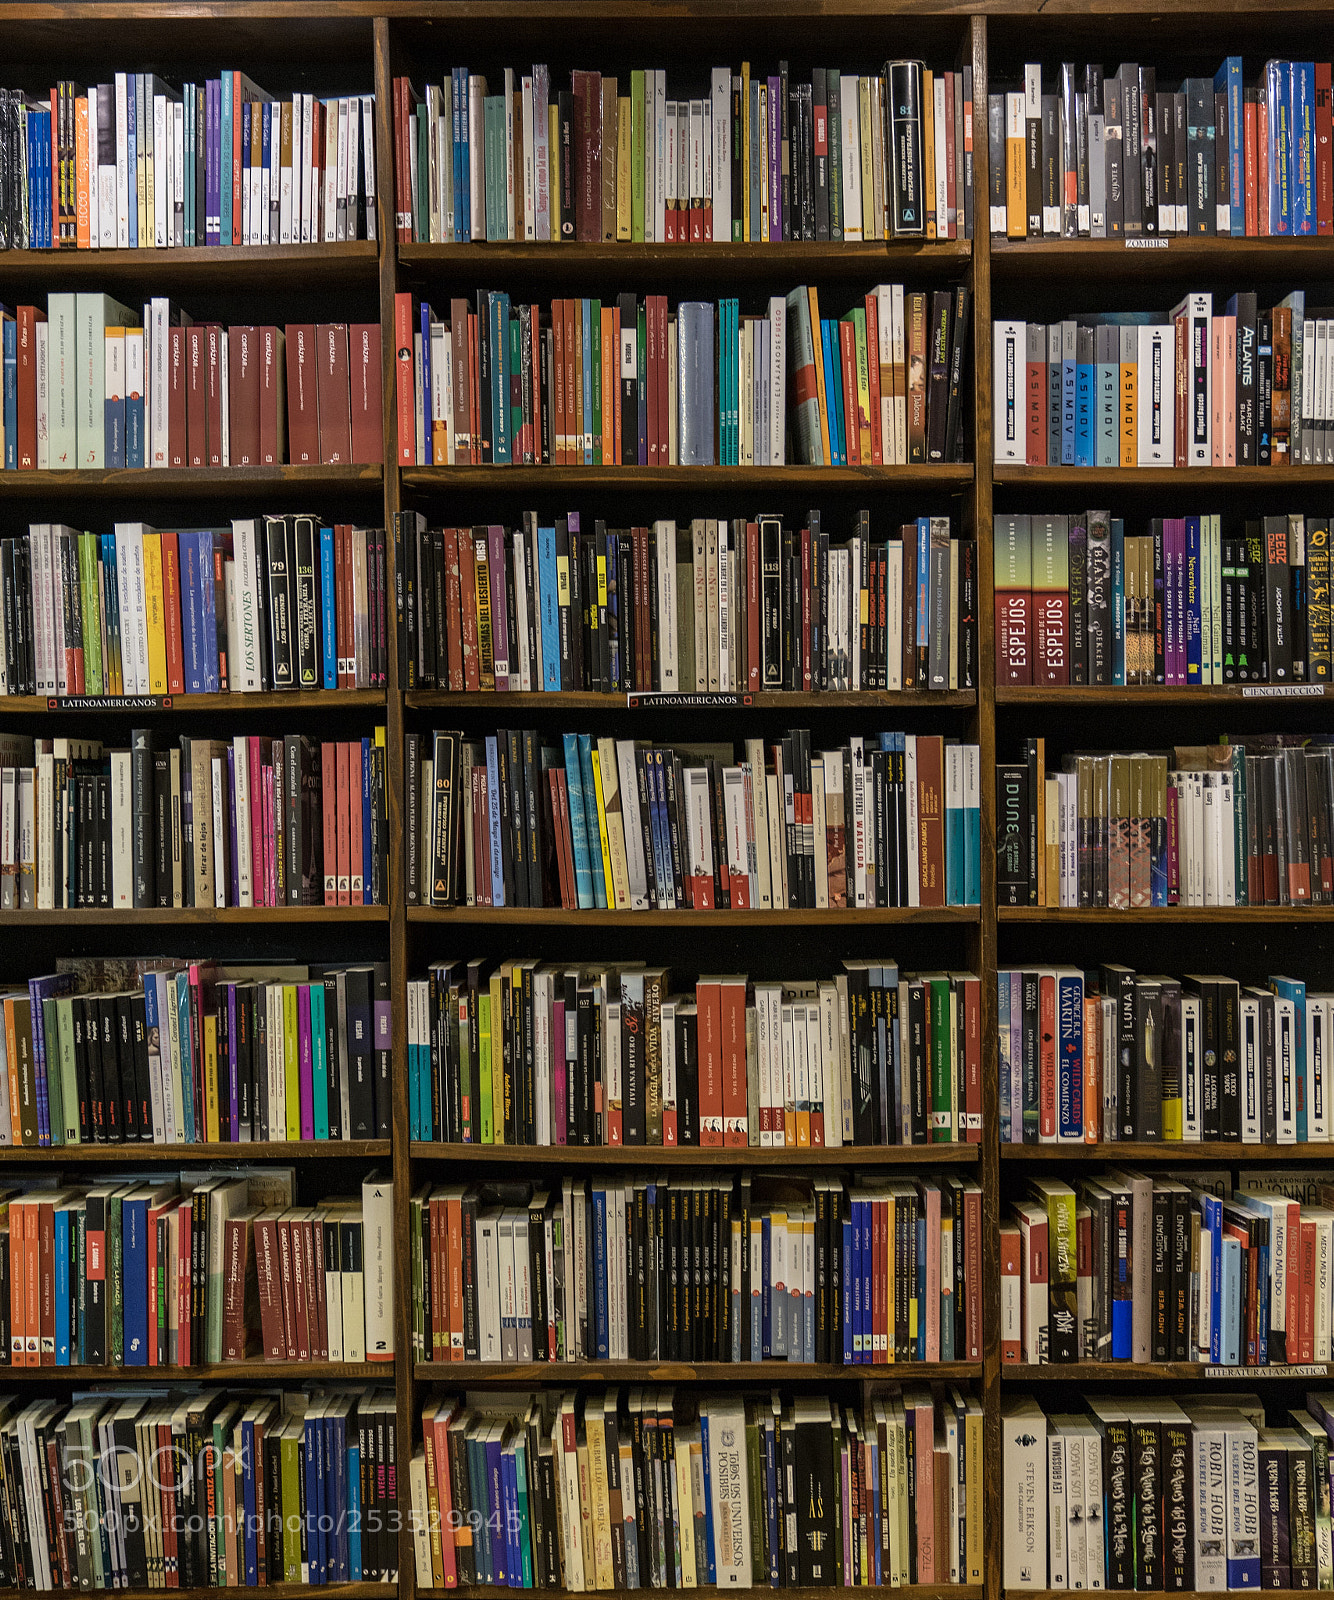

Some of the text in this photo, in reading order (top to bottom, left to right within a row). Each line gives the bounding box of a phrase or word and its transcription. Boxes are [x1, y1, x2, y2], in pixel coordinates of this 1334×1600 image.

[900, 106, 911, 115] 81
[78, 191, 87, 226] CICCO
[1126, 239, 1168, 248] ZOMBIES
[1242, 327, 1254, 386] ATLANTIS
[1080, 372, 1088, 437] ASIMOV
[1125, 370, 1133, 436] ASIMOV
[1252, 538, 1261, 563] 2034
[1268, 533, 1276, 564] METRO
[1276, 533, 1286, 564] 2033
[272, 561, 284, 571] 79
[299, 566, 312, 574] 136
[1072, 554, 1082, 606] NEGRO
[1094, 548, 1103, 603] BLANCO
[476, 540, 492, 674] FANTASMAS DEL DESIERTO ORSI
[243, 590, 255, 672] LOS SERTONES
[1009, 598, 1026, 666] ESPEJOS
[1046, 599, 1064, 667] ESPEJOS
[62, 698, 157, 708] LATINOAMERICANOS
[643, 696, 738, 706] LATINOAMERICANOS
[1244, 688, 1282, 696] CIENCIA
[437, 779, 450, 788] 60
[199, 822, 208, 841] lejos
[200, 843, 207, 852] de
[200, 854, 208, 876] Mirar
[652, 984, 660, 1022] RIVERO
[1062, 986, 1072, 1039] MARTIN
[648, 1027, 658, 1051] VIDA
[1062, 1059, 1068, 1069] EL
[1072, 1059, 1081, 1124] WILD CARDS
[1057, 1202, 1068, 1273] KAZUAKI TAKANO
[1156, 1214, 1164, 1260] MARCIANO
[1176, 1214, 1184, 1260] MARCIANO
[1275, 1226, 1283, 1256] MEDIO
[1156, 1262, 1164, 1272] EL
[1177, 1262, 1184, 1272] EL
[376, 1341, 387, 1350] 2
[1207, 1368, 1266, 1377] LITERATURA
[1199, 1442, 1206, 1452] LA
[1232, 1441, 1239, 1451] LA
[388, 1466, 396, 1499] LA VECINA
[718, 1452, 729, 1500] POSIBLES
[1052, 1442, 1062, 1494] LEV GROSSMAN
[1266, 1460, 1279, 1487] ROBIN
[378, 1490, 386, 1498] LA
[1210, 1441, 1223, 1535] ROBIN HOBB
[1243, 1441, 1257, 1535] ROBIN HOBB
[1269, 1487, 1280, 1512] HOBB
[1294, 1460, 1307, 1512] ROBIN HOBB
[1026, 1462, 1034, 1553] STEVEN ERIKSON
[731, 1501, 743, 1567] UNIVERSOS
[920, 1536, 931, 1572] TIZÓN
